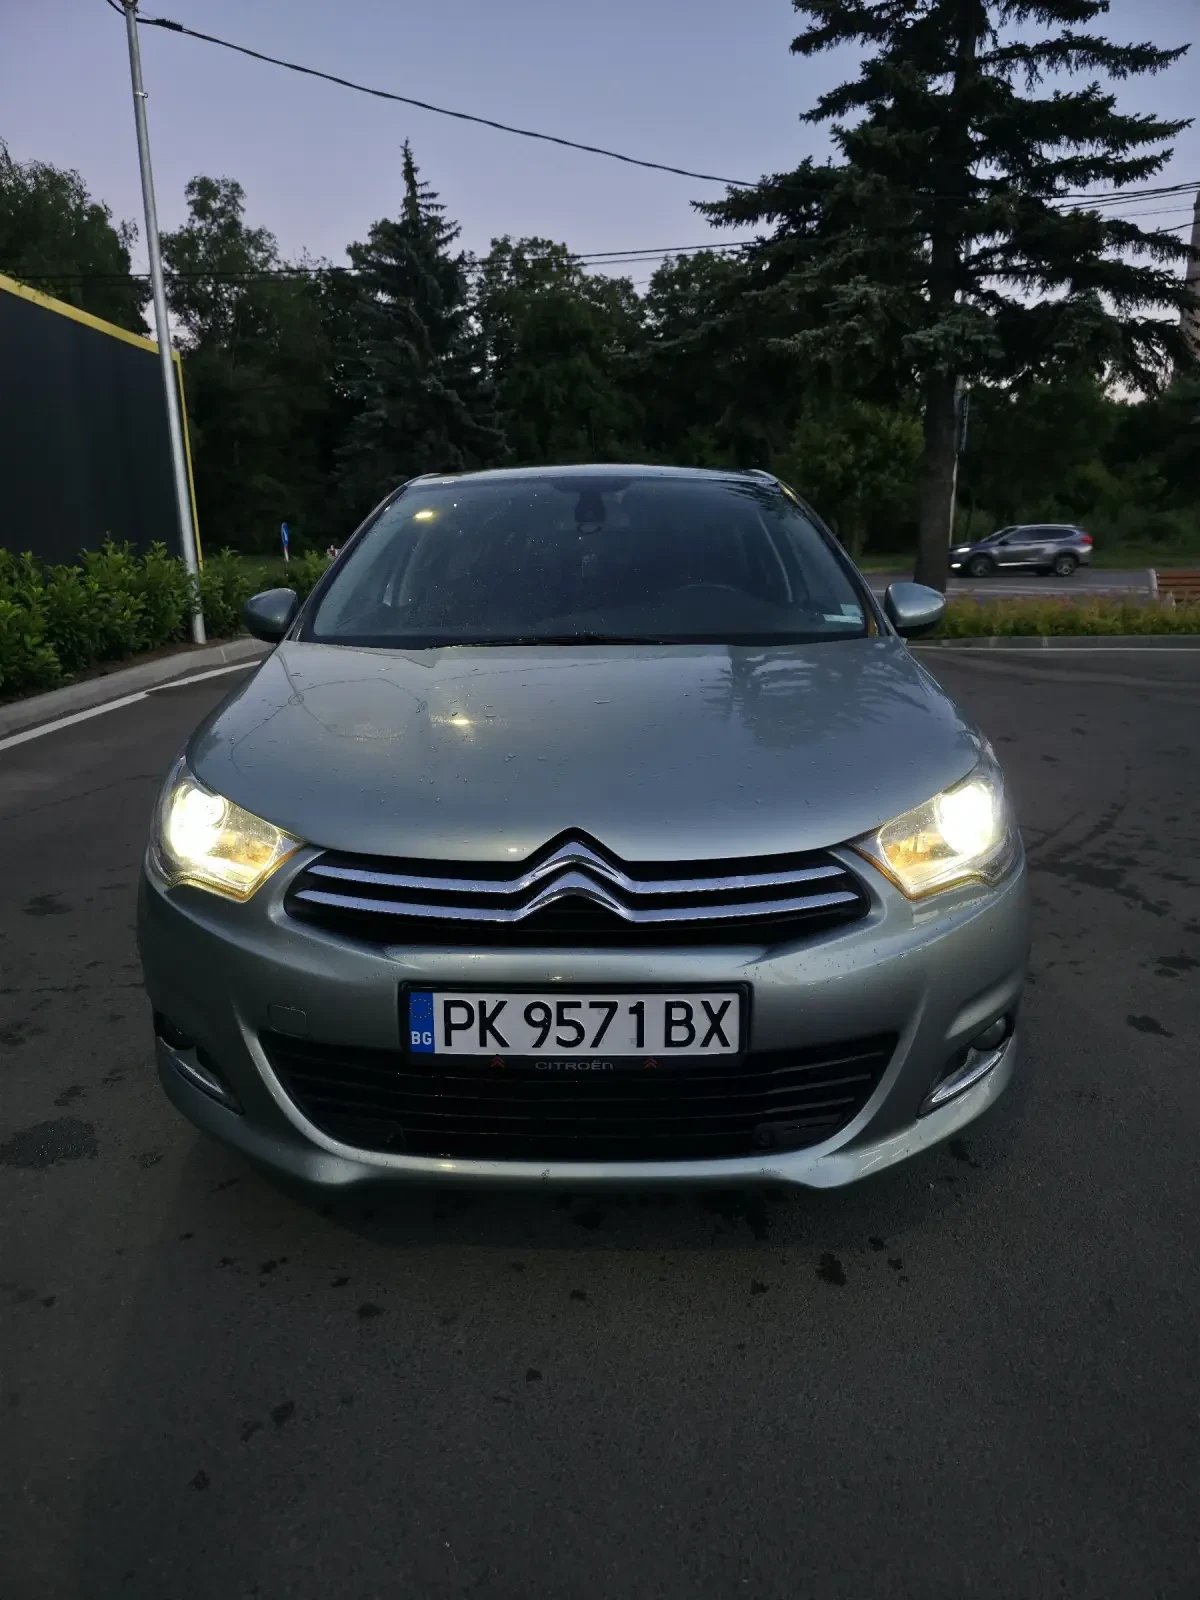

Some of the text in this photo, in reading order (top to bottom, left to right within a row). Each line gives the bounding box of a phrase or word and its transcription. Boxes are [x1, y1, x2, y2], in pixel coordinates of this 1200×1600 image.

[410, 1031, 432, 1045] BG
[443, 1000, 732, 1049] PK 9571 BX
